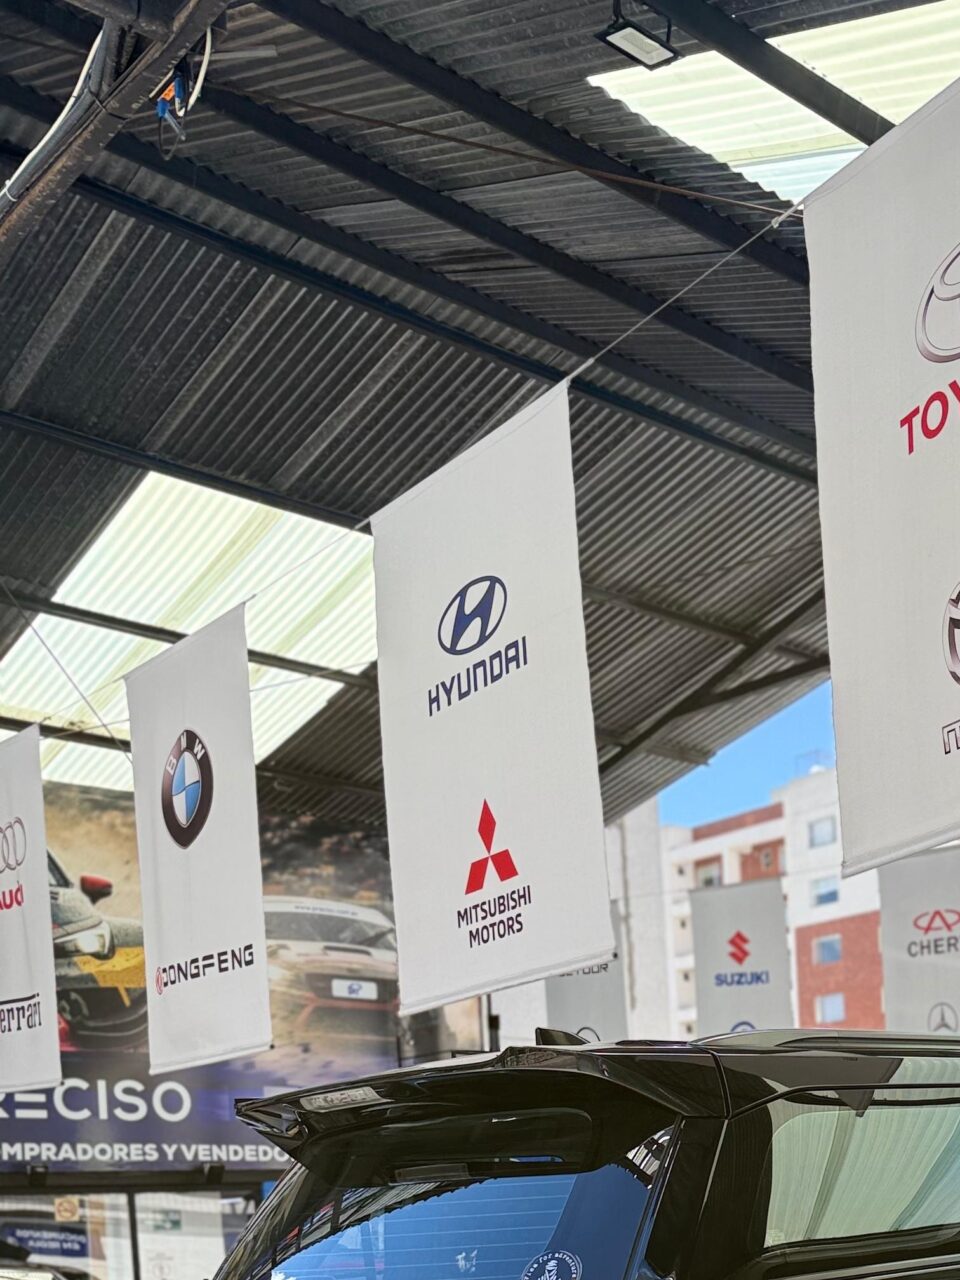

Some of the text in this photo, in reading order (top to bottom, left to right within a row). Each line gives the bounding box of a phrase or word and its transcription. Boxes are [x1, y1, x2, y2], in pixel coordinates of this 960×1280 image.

[427, 635, 529, 717] HYUNDAI
[456, 885, 532, 928] MITSUBISHI
[469, 918, 524, 948] MOTORS
[162, 943, 255, 988] DONGFENG
[714, 970, 769, 987] SUZUKI
[0, 1001, 42, 1034] errari
[161, 1144, 181, 1161] Y
